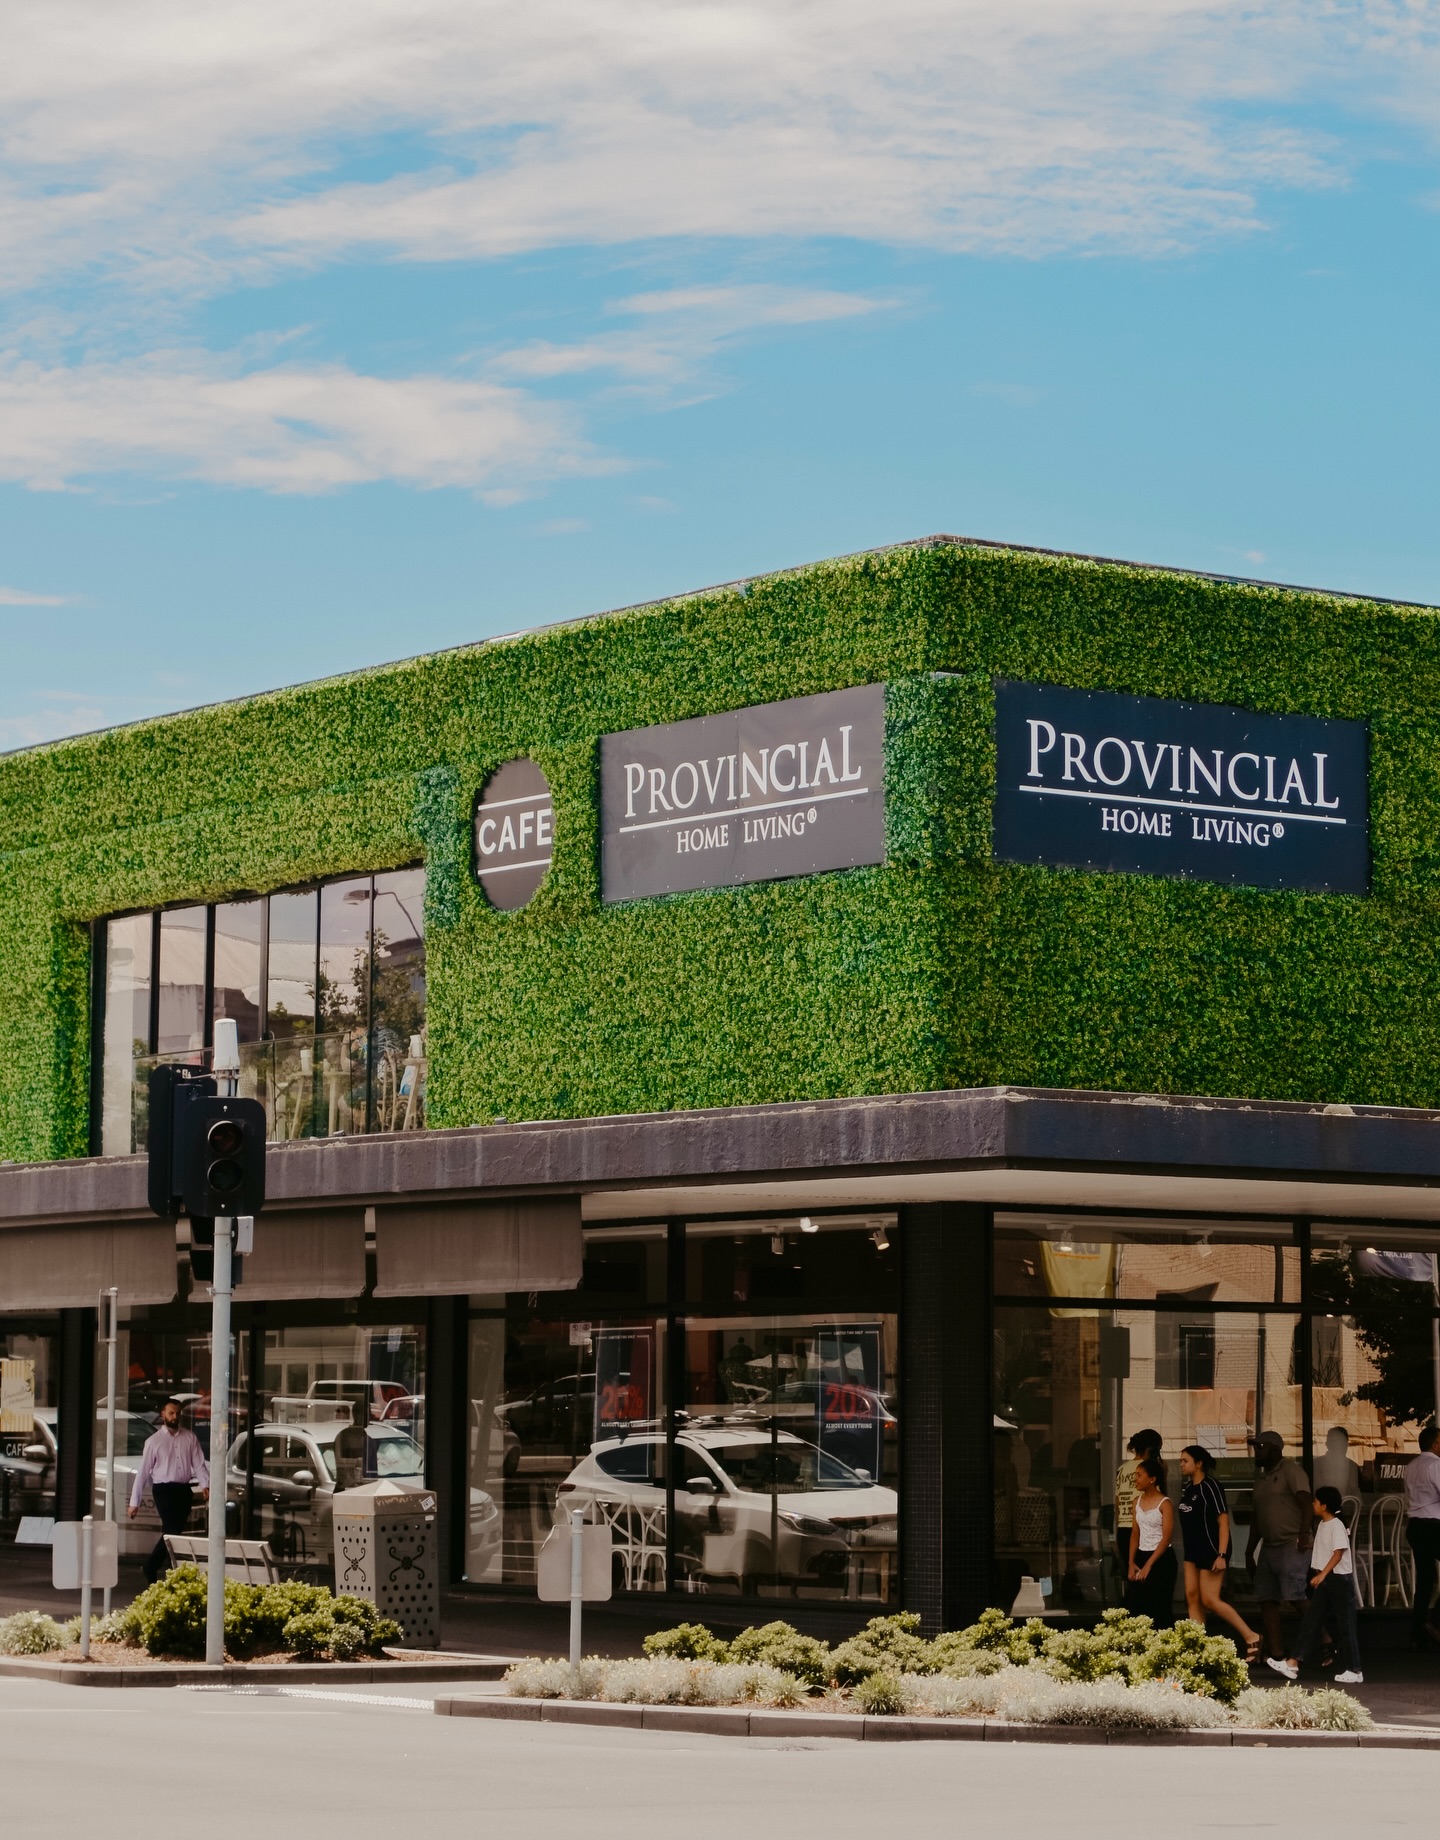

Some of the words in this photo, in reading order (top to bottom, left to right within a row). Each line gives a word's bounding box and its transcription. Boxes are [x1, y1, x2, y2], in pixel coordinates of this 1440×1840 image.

[623, 724, 862, 818] PROVINCIAL
[1026, 719, 1340, 809] PROVINCIAL
[478, 807, 553, 855] CAFE
[676, 824, 729, 854] HOME
[1101, 807, 1172, 837] HOME
